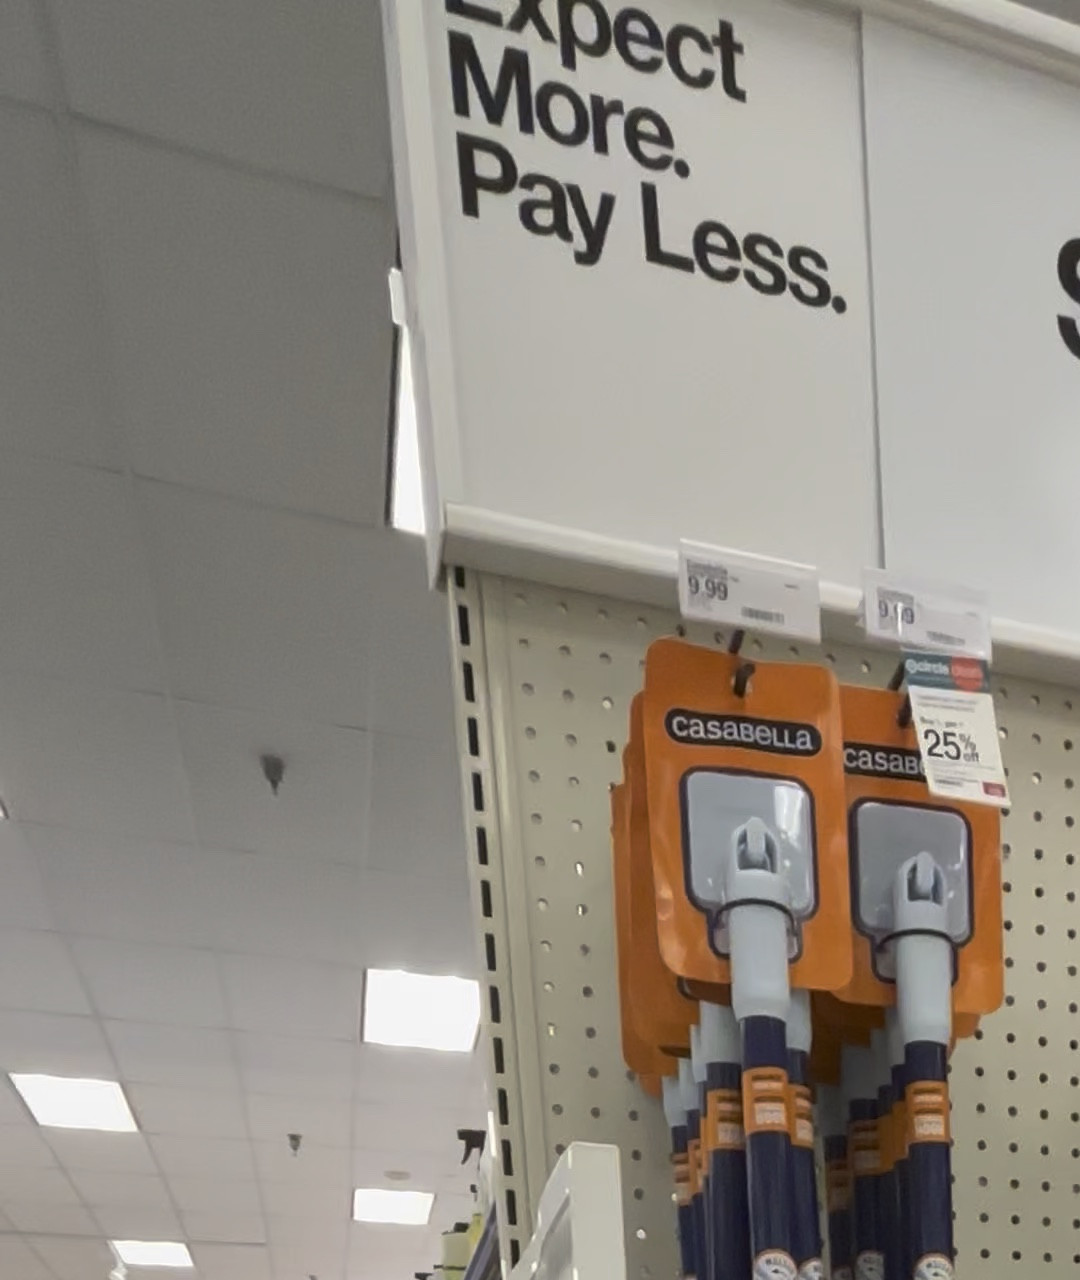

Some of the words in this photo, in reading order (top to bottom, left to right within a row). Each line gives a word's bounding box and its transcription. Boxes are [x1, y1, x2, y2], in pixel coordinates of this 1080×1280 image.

[445, 0, 747, 103] xpect
[447, 29, 691, 179] More.
[455, 131, 616, 266] Pay
[640, 181, 847, 314] Less.
[688, 575, 729, 601] 9.99
